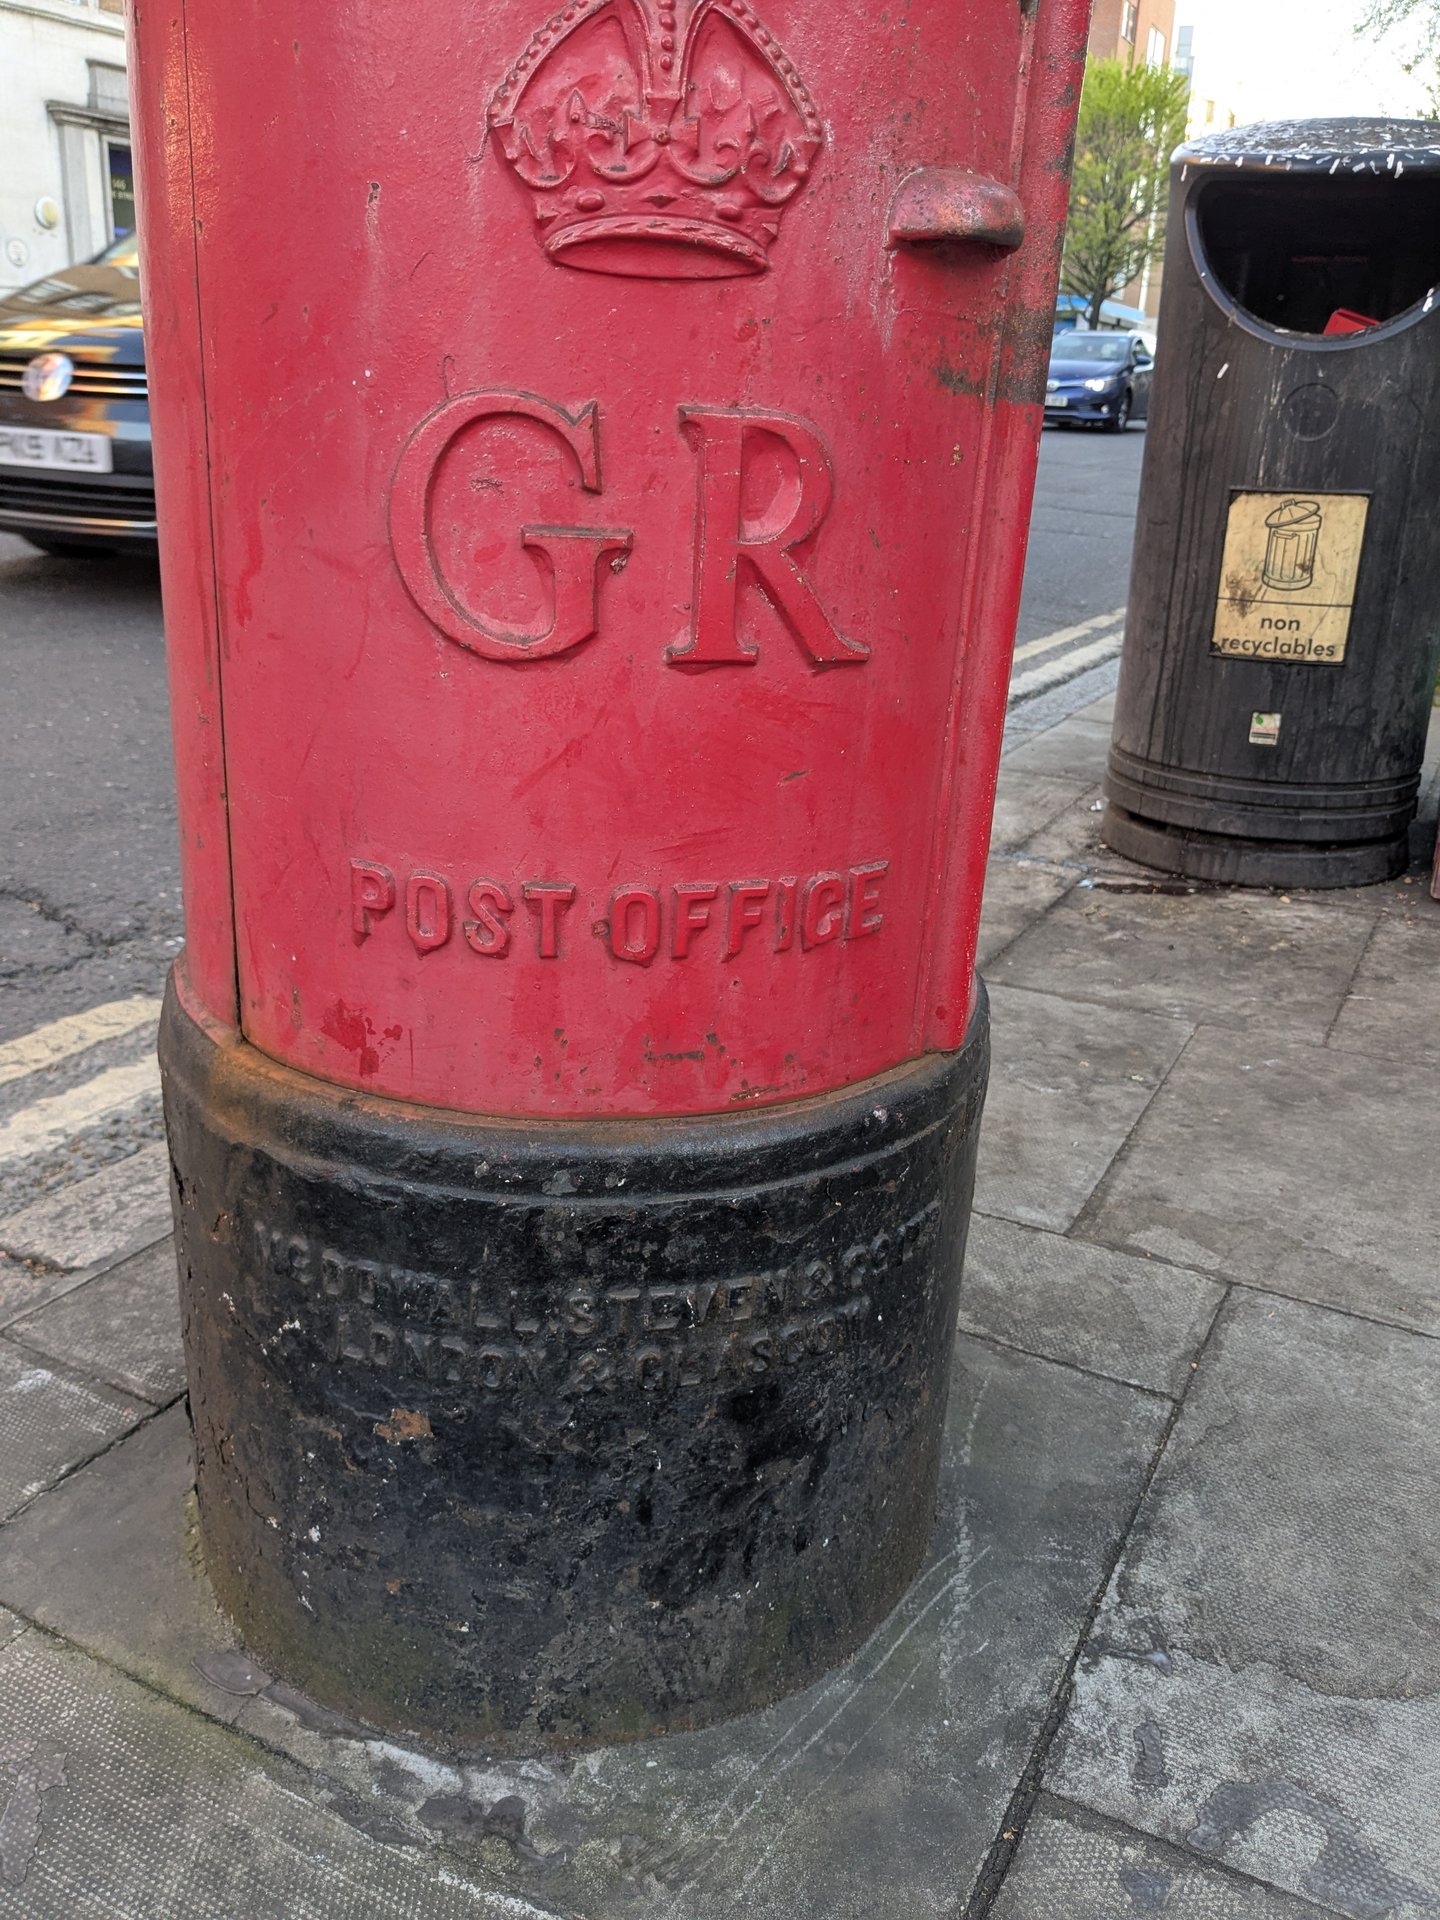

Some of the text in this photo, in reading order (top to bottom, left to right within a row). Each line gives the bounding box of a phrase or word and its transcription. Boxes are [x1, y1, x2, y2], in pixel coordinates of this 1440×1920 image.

[1260, 617, 1301, 631] non
[1221, 637, 1336, 656] recyclables
[350, 858, 890, 966] POST OFFICE
[801, 1259, 834, 1302] &
